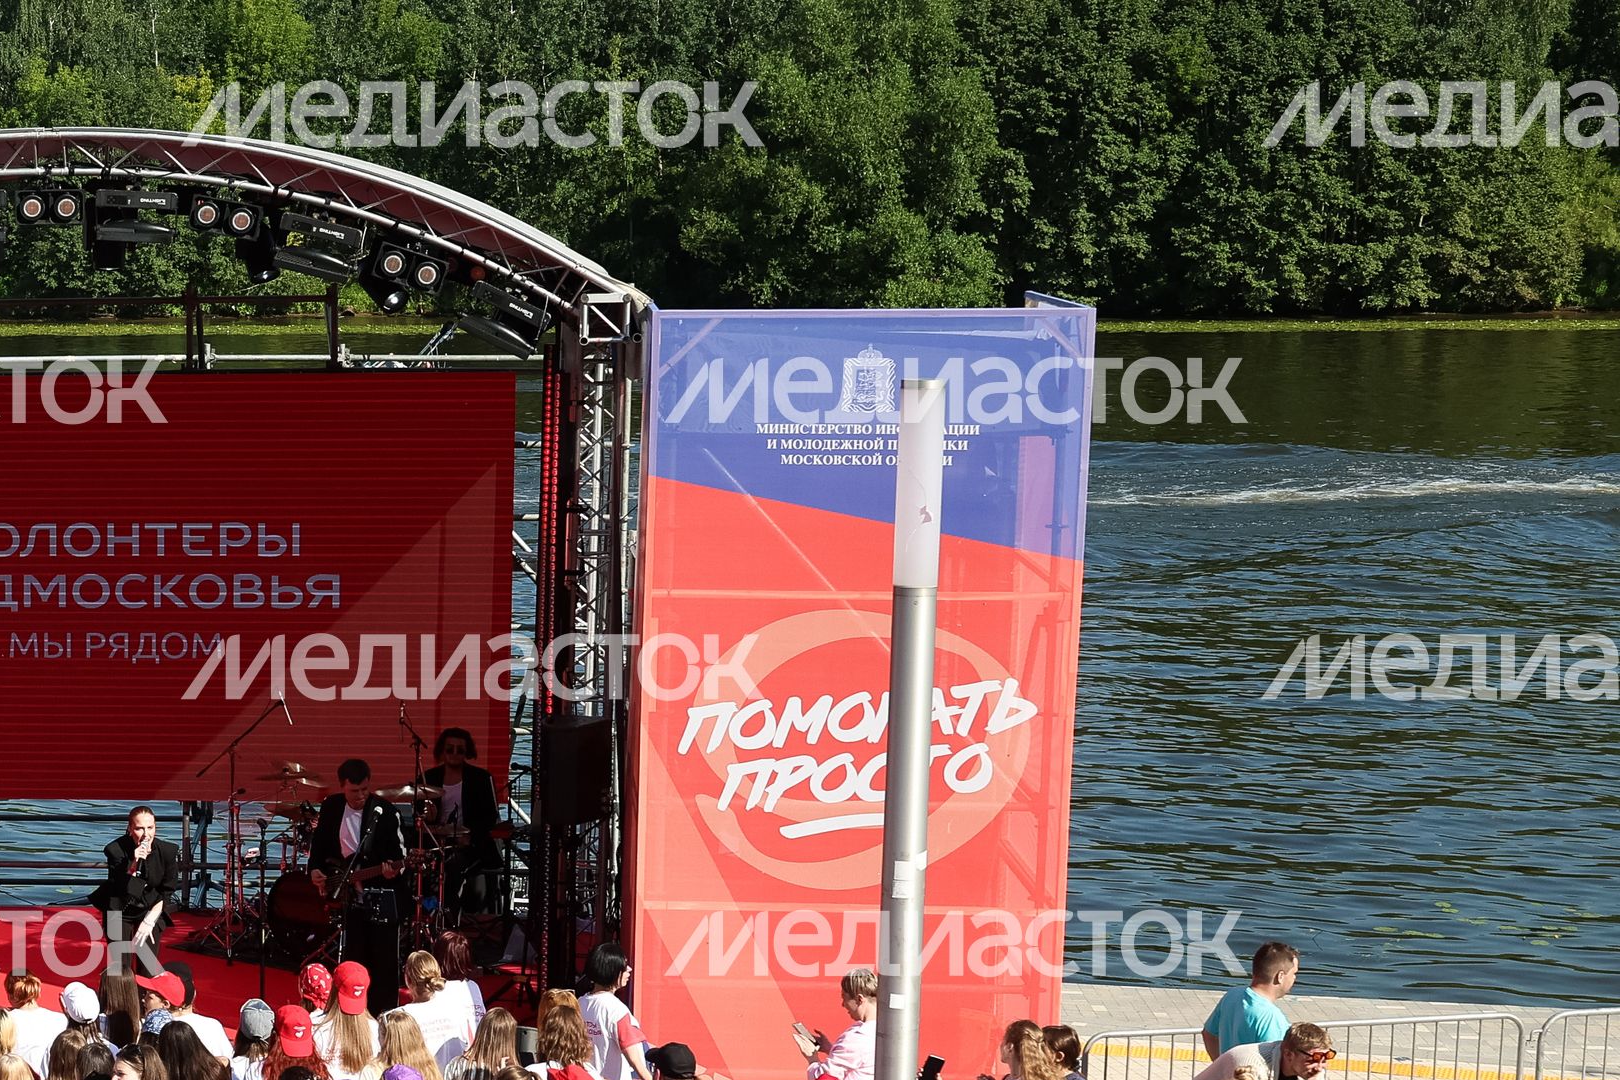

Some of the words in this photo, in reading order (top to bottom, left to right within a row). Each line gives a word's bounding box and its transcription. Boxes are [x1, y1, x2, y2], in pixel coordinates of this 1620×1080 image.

[756, 423, 873, 436] МИНИСТЕРСТВО
[766, 439, 777, 450] И
[780, 437, 884, 452] МОЛОДЕЖНОЙ
[780, 453, 882, 466] МОСКОВСКОЙ
[8, 632, 73, 660] МЫ
[85, 632, 224, 665] РЯДОМ
